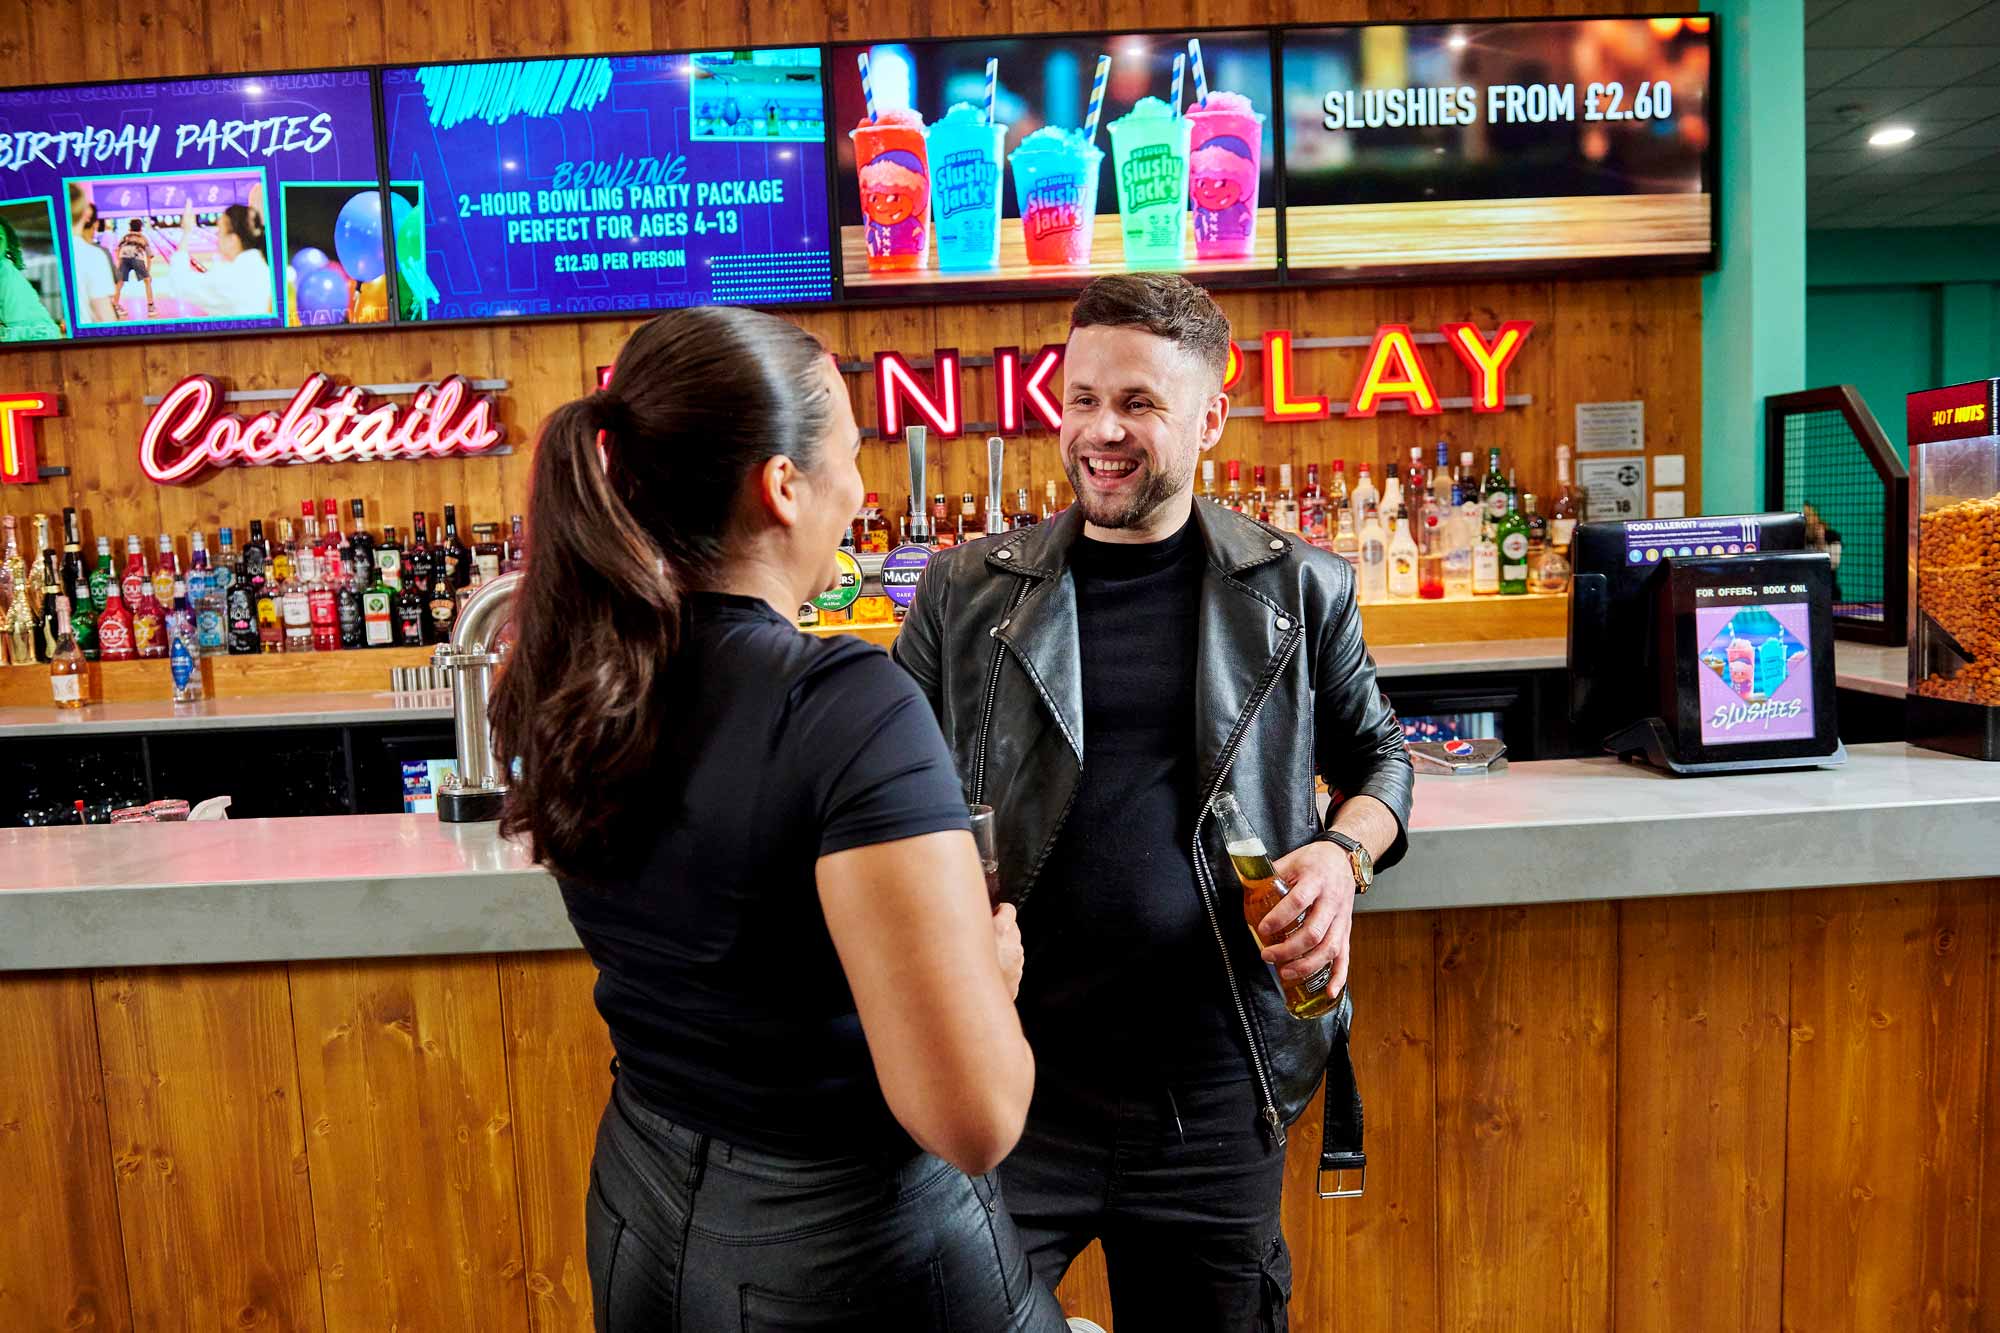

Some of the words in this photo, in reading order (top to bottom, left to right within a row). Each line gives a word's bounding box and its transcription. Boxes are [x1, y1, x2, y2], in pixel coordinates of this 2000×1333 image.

[1323, 85, 1478, 130] SLUSHIES
[1488, 83, 1576, 124] FROM
[1584, 80, 1673, 121] £2.60
[0, 124, 161, 173] BIRTHDAY
[176, 112, 333, 166] PARTIES
[552, 152, 687, 190] BOWLING
[936, 160, 997, 192] Slushy
[1123, 155, 1182, 185] Slushy
[120, 189, 131, 208] 6
[164, 186, 176, 206] 7
[207, 185, 219, 203] 8
[459, 191, 532, 218] 2-HOUR
[537, 186, 625, 214] BOWLING
[630, 182, 691, 209] PARTY
[696, 179, 784, 207] PACKAGE
[943, 183, 994, 215] Jack's
[1027, 184, 1089, 214] Slushy
[1128, 178, 1180, 209] Jack's
[508, 216, 590, 244] PERFECT
[596, 214, 634, 240] FOR
[639, 212, 689, 238] AGES
[694, 209, 739, 235] 4-13
[1034, 205, 1083, 236] Jack's
[554, 254, 599, 273] £12.50
[602, 252, 630, 271] PER
[632, 249, 687, 269] PERSON
[139, 372, 508, 485] Cocktails
[1932, 408, 1953, 426] HOT
[1954, 404, 1985, 423] NUTS
[1627, 523, 1654, 532] FOOD
[1655, 520, 1697, 531] ALLERGY?
[883, 571, 922, 583] MAGN
[1695, 588, 1715, 598] FOR
[1717, 586, 1758, 597] OFFERS,
[1762, 584, 1787, 595] BOOK
[1711, 697, 1803, 731] SLUSHIES
